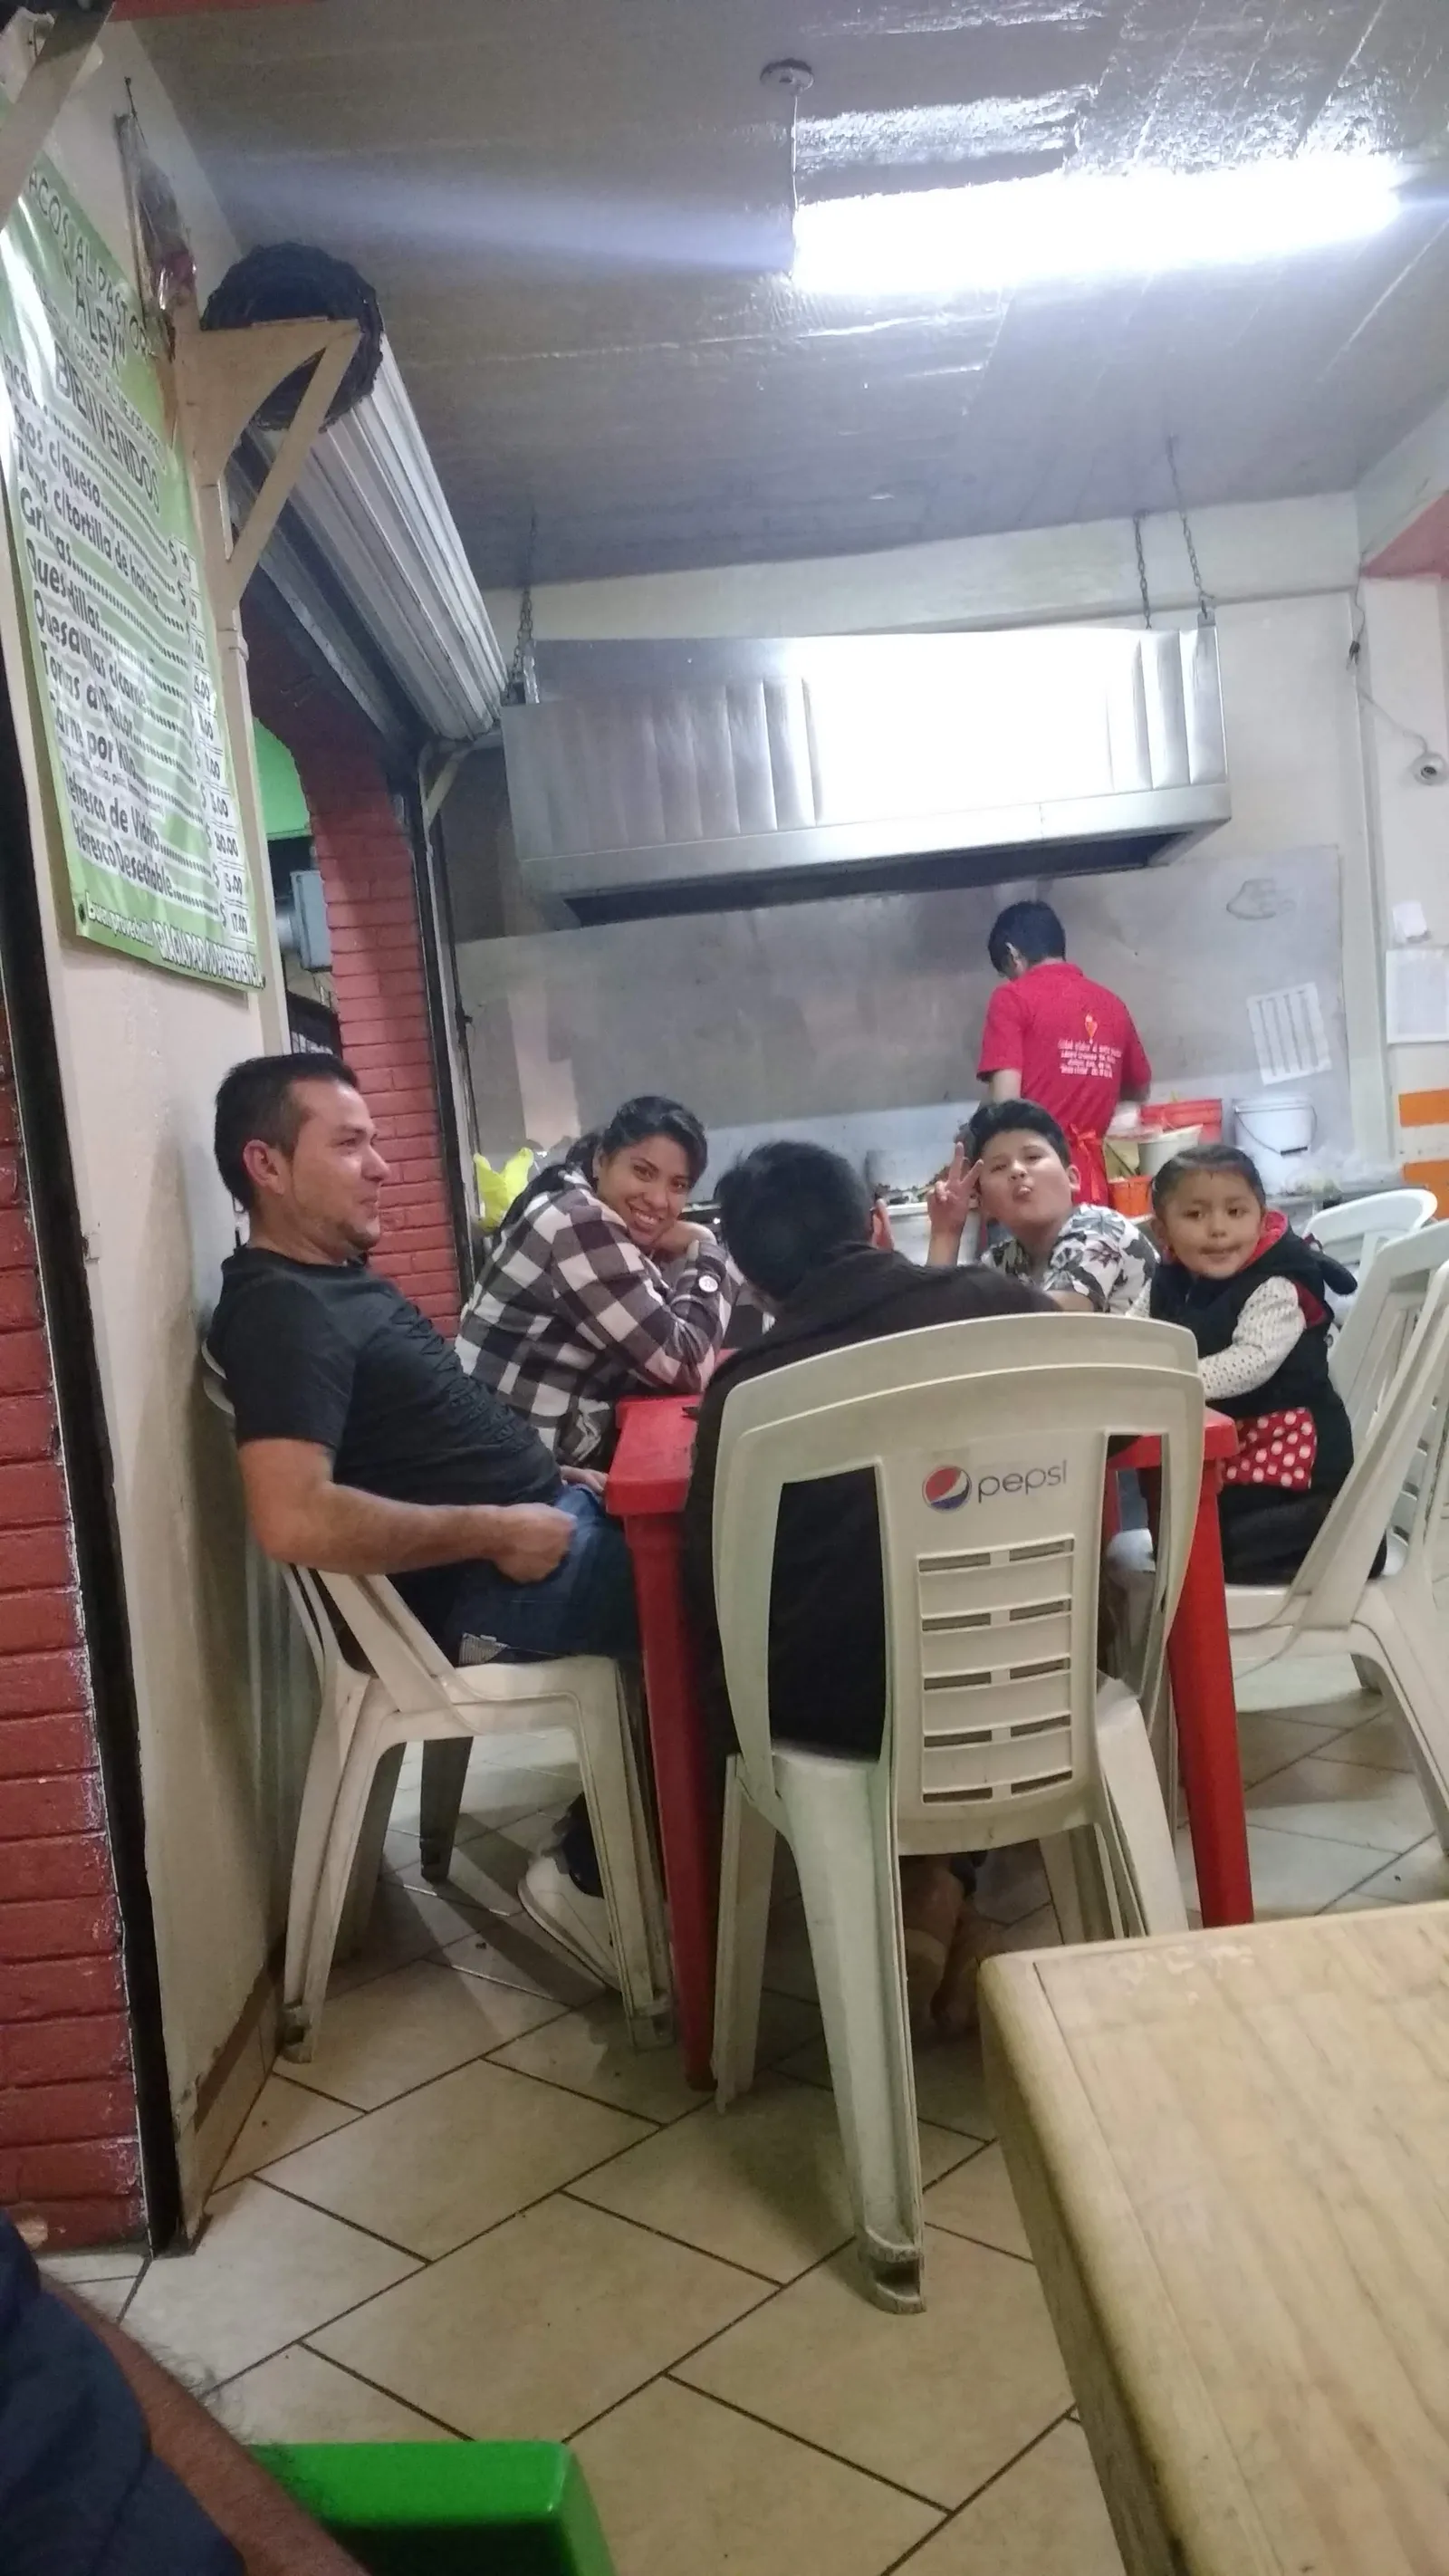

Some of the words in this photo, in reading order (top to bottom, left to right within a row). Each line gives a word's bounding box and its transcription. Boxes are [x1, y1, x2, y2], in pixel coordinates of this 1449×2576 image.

[29, 167, 68, 249] ACOS
[75, 236, 91, 284] AL
[54, 341, 159, 514] BIENVENIDOS
[50, 440, 101, 507] c/queso
[54, 487, 111, 561] c/tortilla
[115, 541, 129, 577] de
[51, 691, 84, 746] arne
[87, 730, 113, 763] por
[110, 797, 129, 833] de
[130, 803, 159, 851] Vidrio
[114, 840, 173, 897] Desechable
